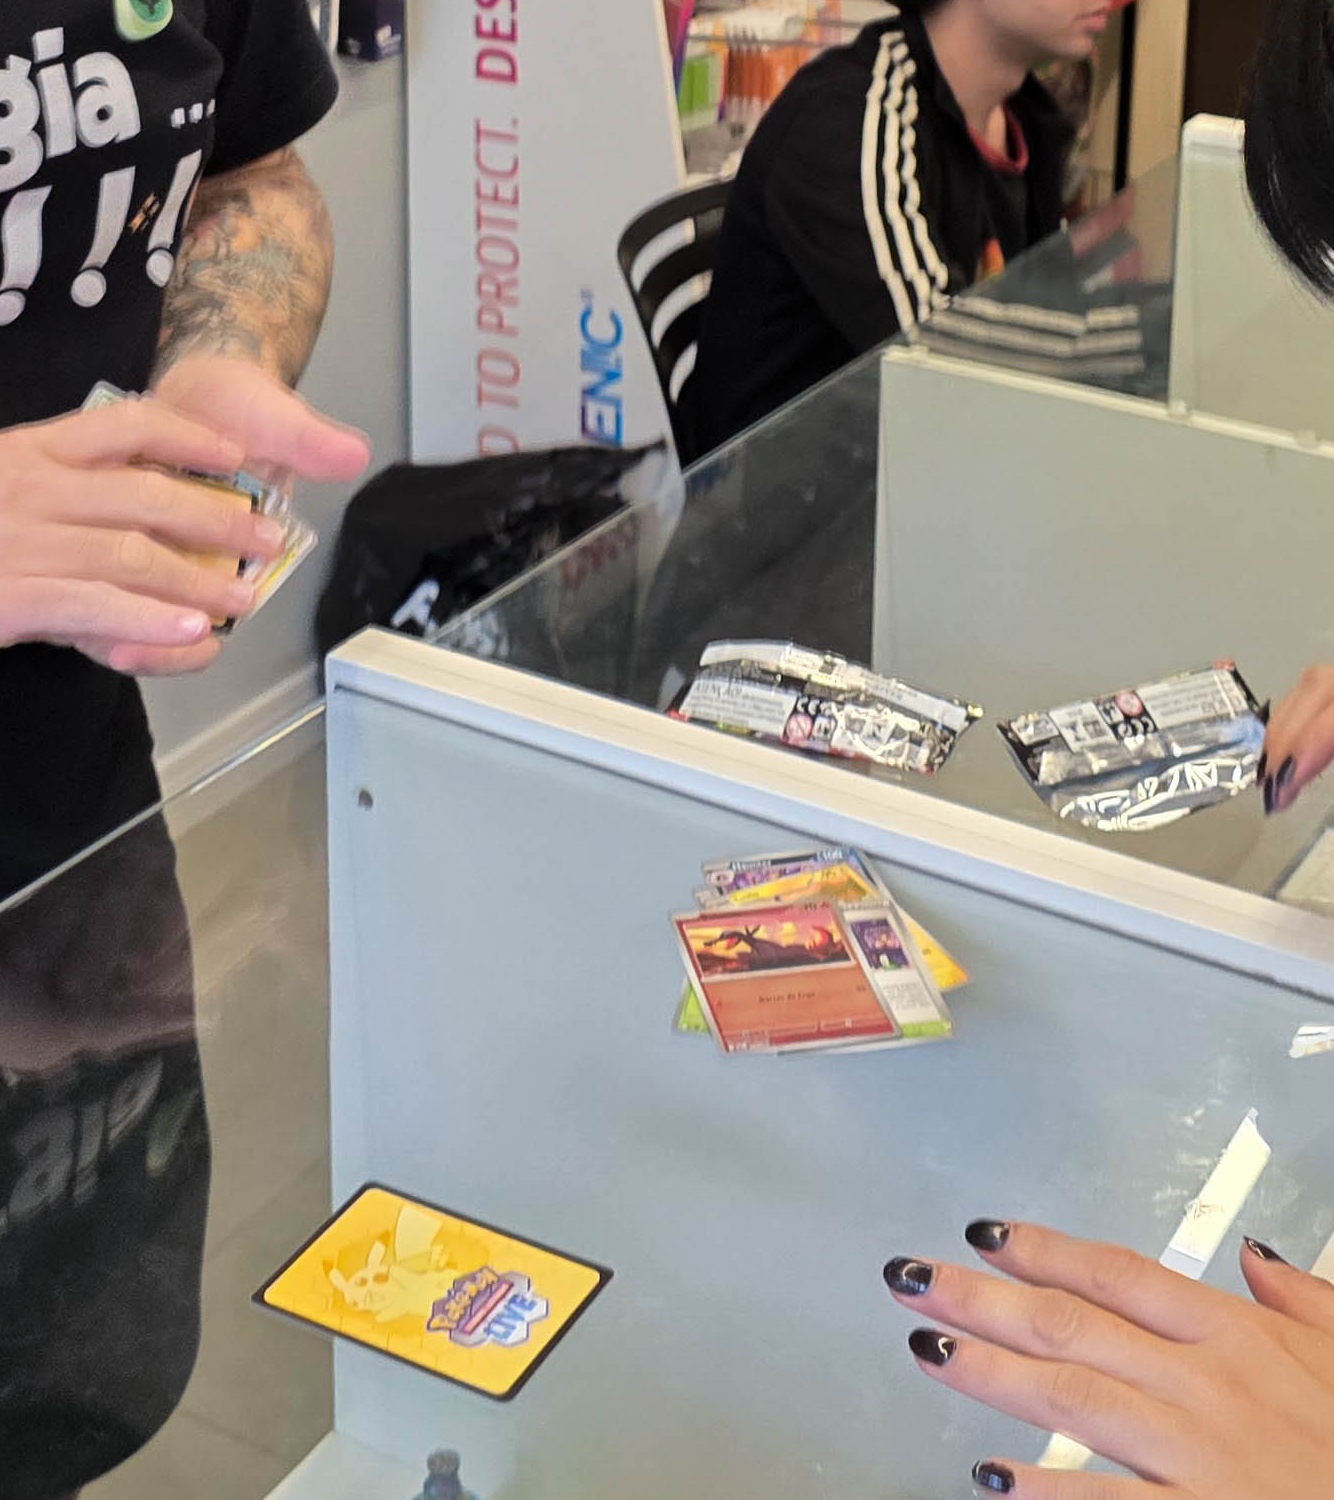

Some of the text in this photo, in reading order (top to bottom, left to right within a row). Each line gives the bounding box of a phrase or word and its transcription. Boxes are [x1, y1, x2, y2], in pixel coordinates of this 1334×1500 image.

[475, 116, 522, 337] PROTECT.
[475, 349, 522, 411] TO
[483, 1293, 539, 1341] LIVE
